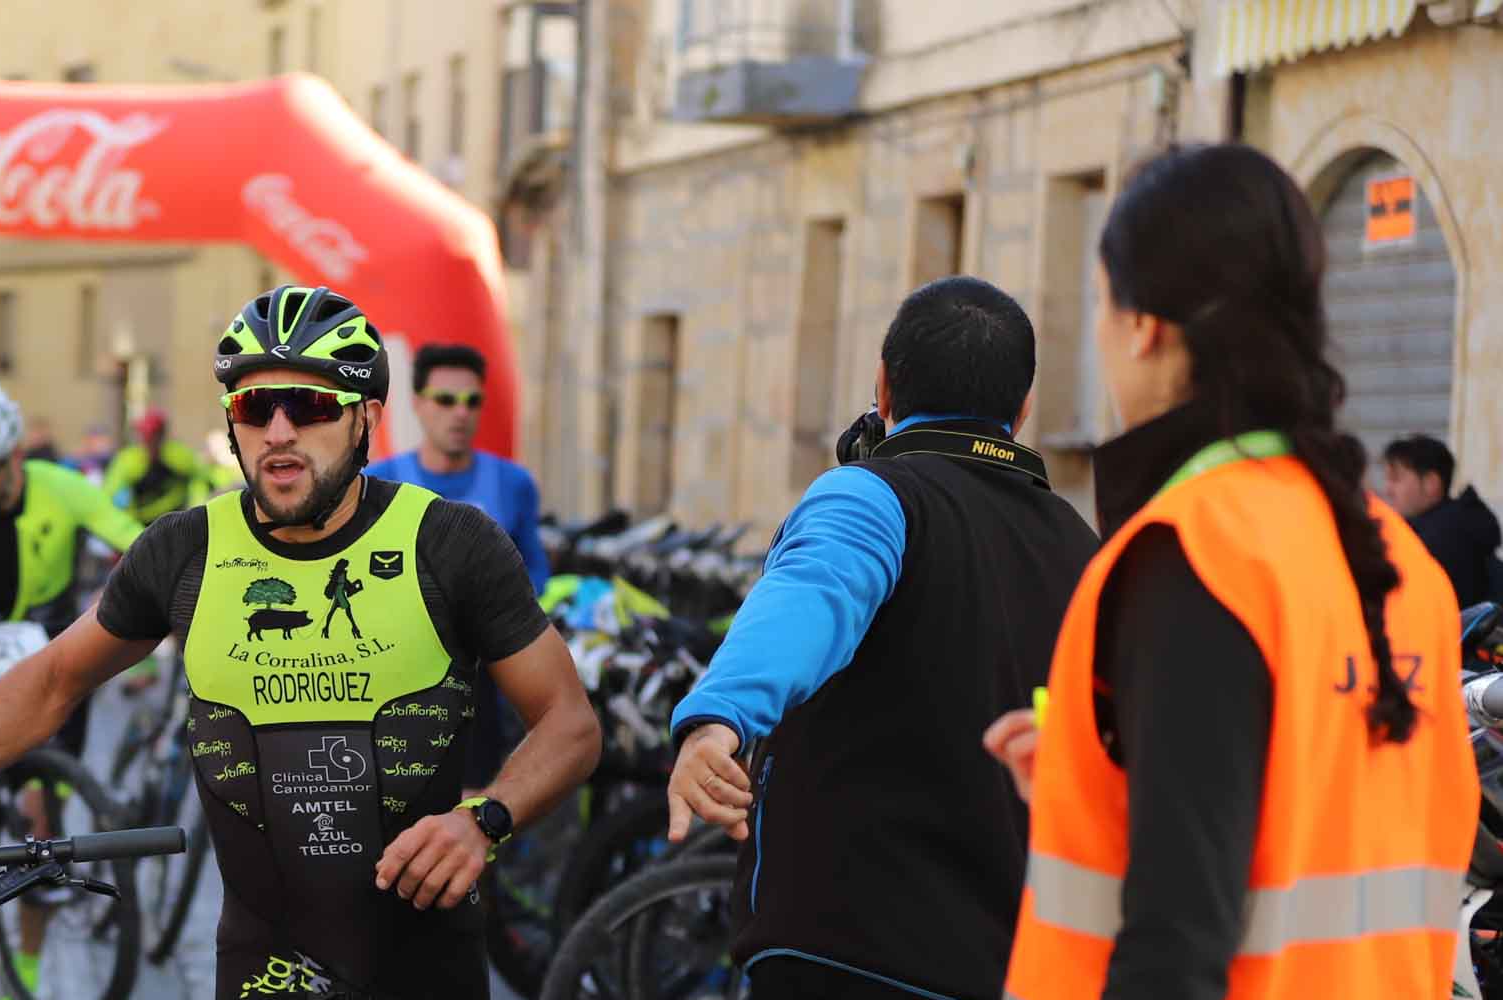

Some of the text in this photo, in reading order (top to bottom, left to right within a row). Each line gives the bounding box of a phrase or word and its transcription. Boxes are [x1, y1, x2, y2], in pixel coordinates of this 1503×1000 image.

[972, 440, 1015, 462] Nikon
[227, 637, 396, 669] La Corralina, S.L.
[253, 671, 374, 706] RODRIGUEZ
[272, 771, 323, 783] Clínica
[272, 784, 374, 795] Campoamor
[291, 800, 357, 814] AMTEL
[308, 831, 352, 843] AZUL
[299, 843, 363, 856] TELECO
